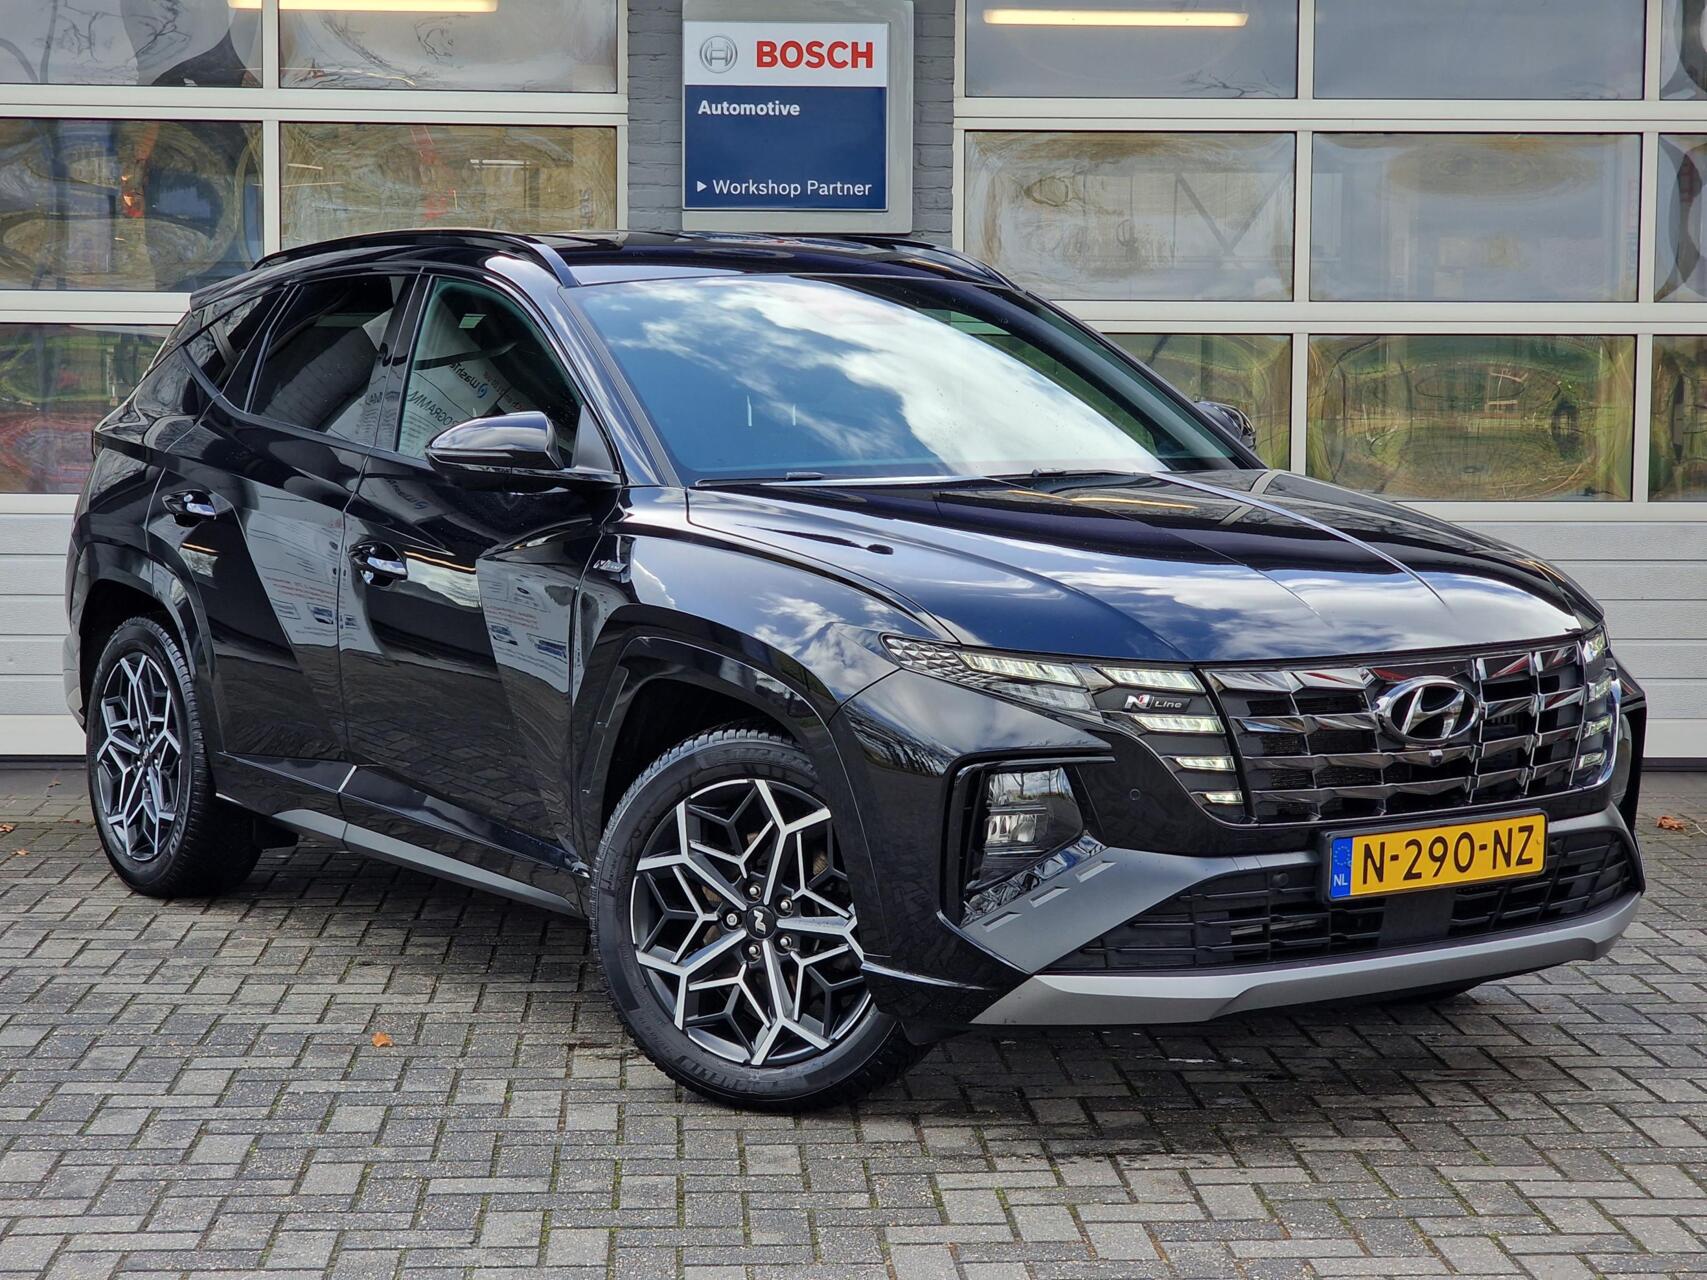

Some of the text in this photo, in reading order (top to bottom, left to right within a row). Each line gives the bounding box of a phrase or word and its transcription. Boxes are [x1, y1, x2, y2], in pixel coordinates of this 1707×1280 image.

[756, 40, 873, 69] BOSCH
[698, 100, 801, 116] Automotive
[712, 179, 872, 198] Workshop Partner
[1362, 824, 1535, 885] N-290-NZ
[1333, 873, 1348, 887] NL
